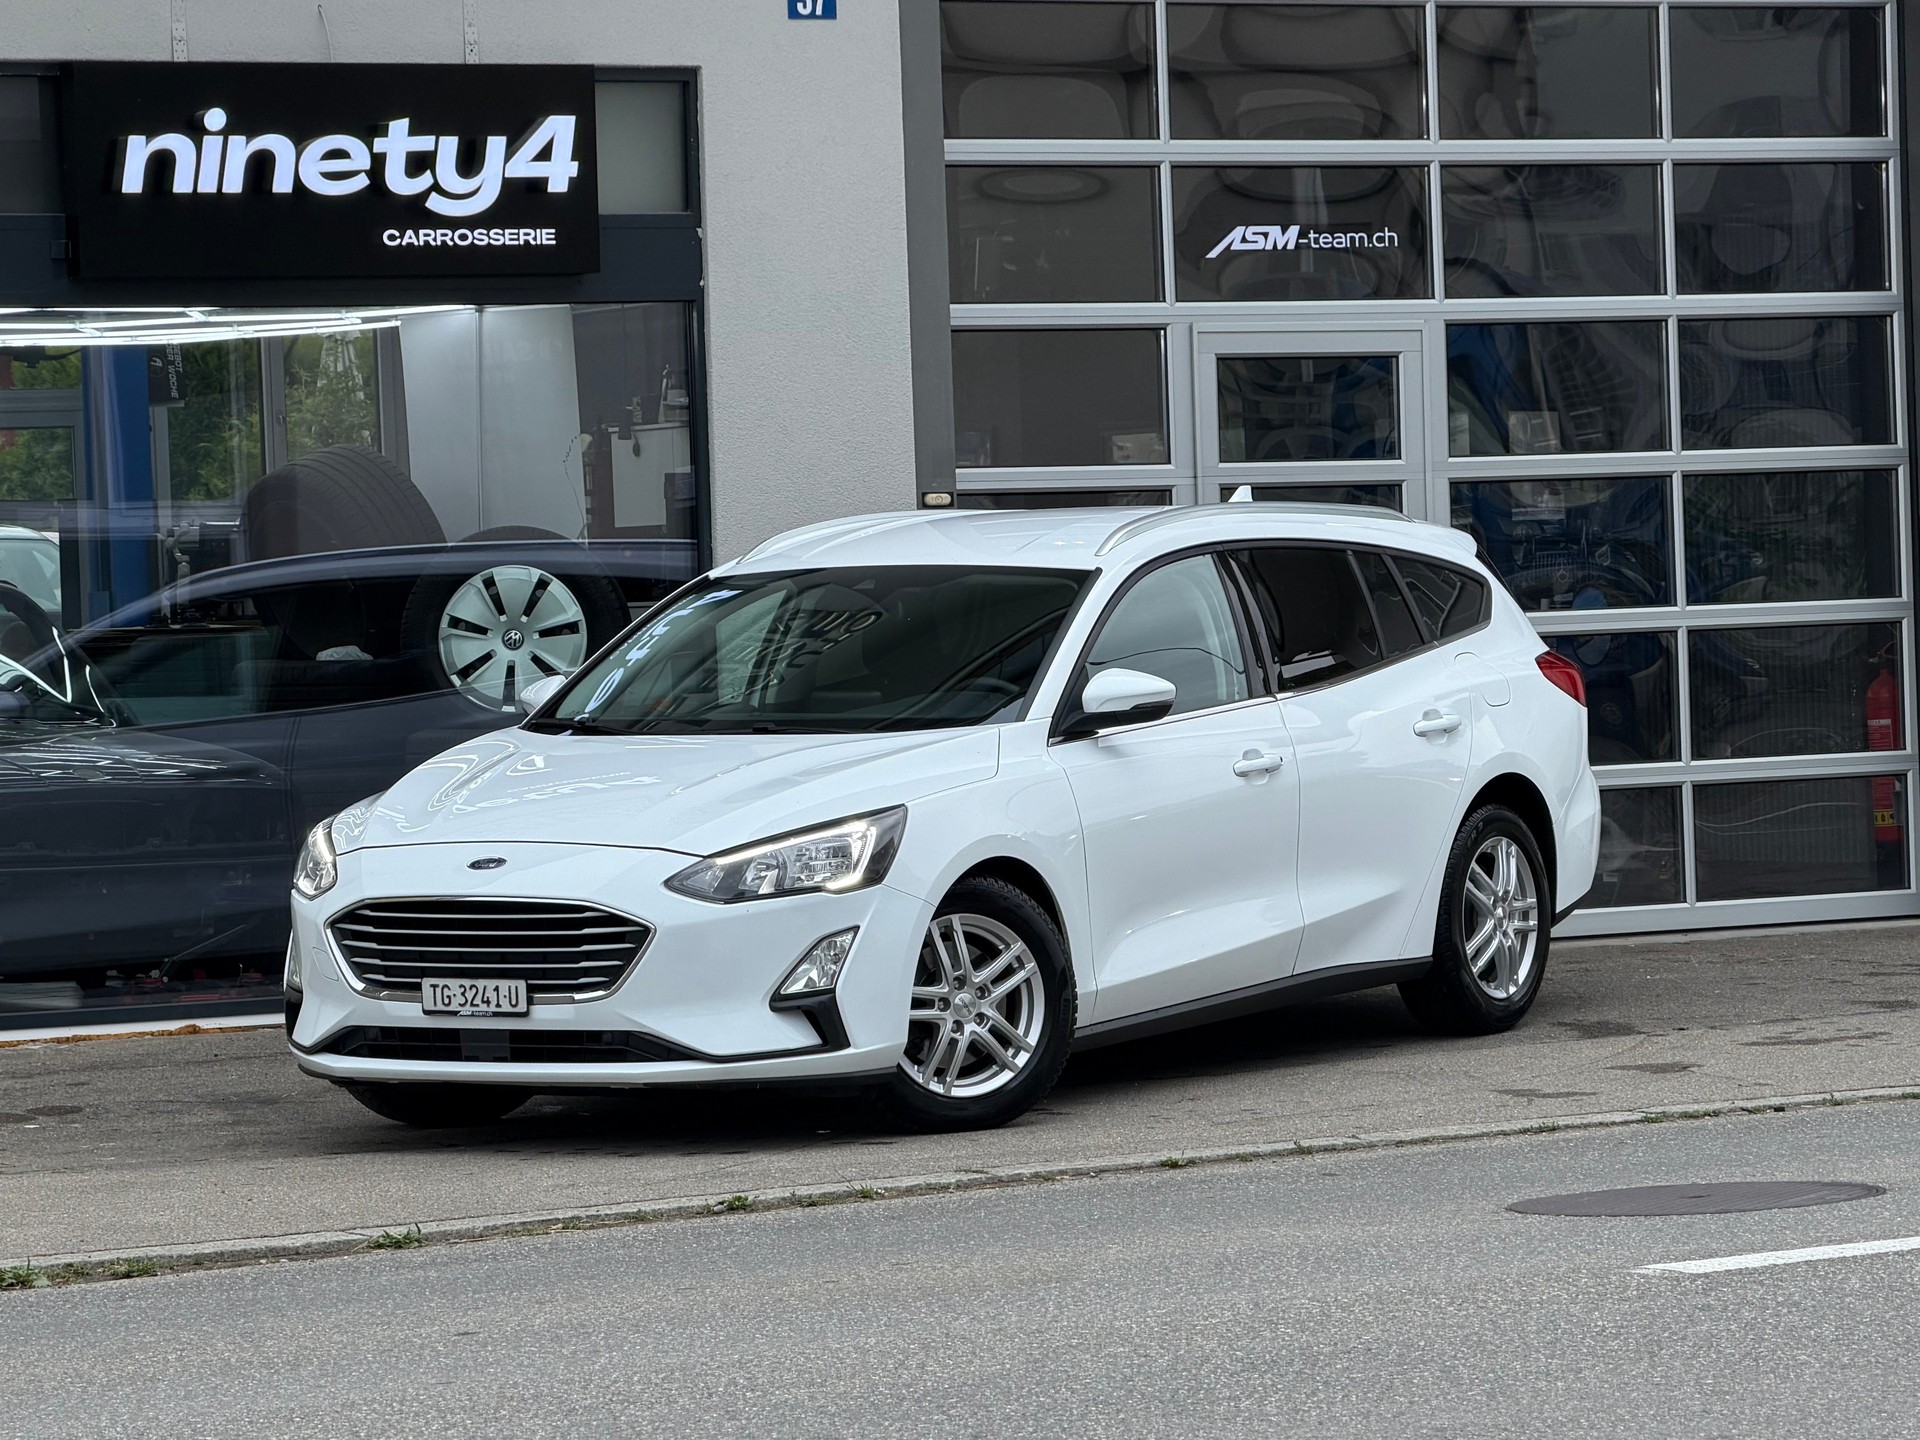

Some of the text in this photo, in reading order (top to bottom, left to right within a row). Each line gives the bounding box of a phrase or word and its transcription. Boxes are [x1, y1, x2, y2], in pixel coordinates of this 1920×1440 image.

[121, 108, 579, 216] ninety4
[382, 228, 557, 246] CARROSSERIE
[1205, 225, 1399, 259] ASM-team.ch
[168, 364, 179, 399] WOCHE
